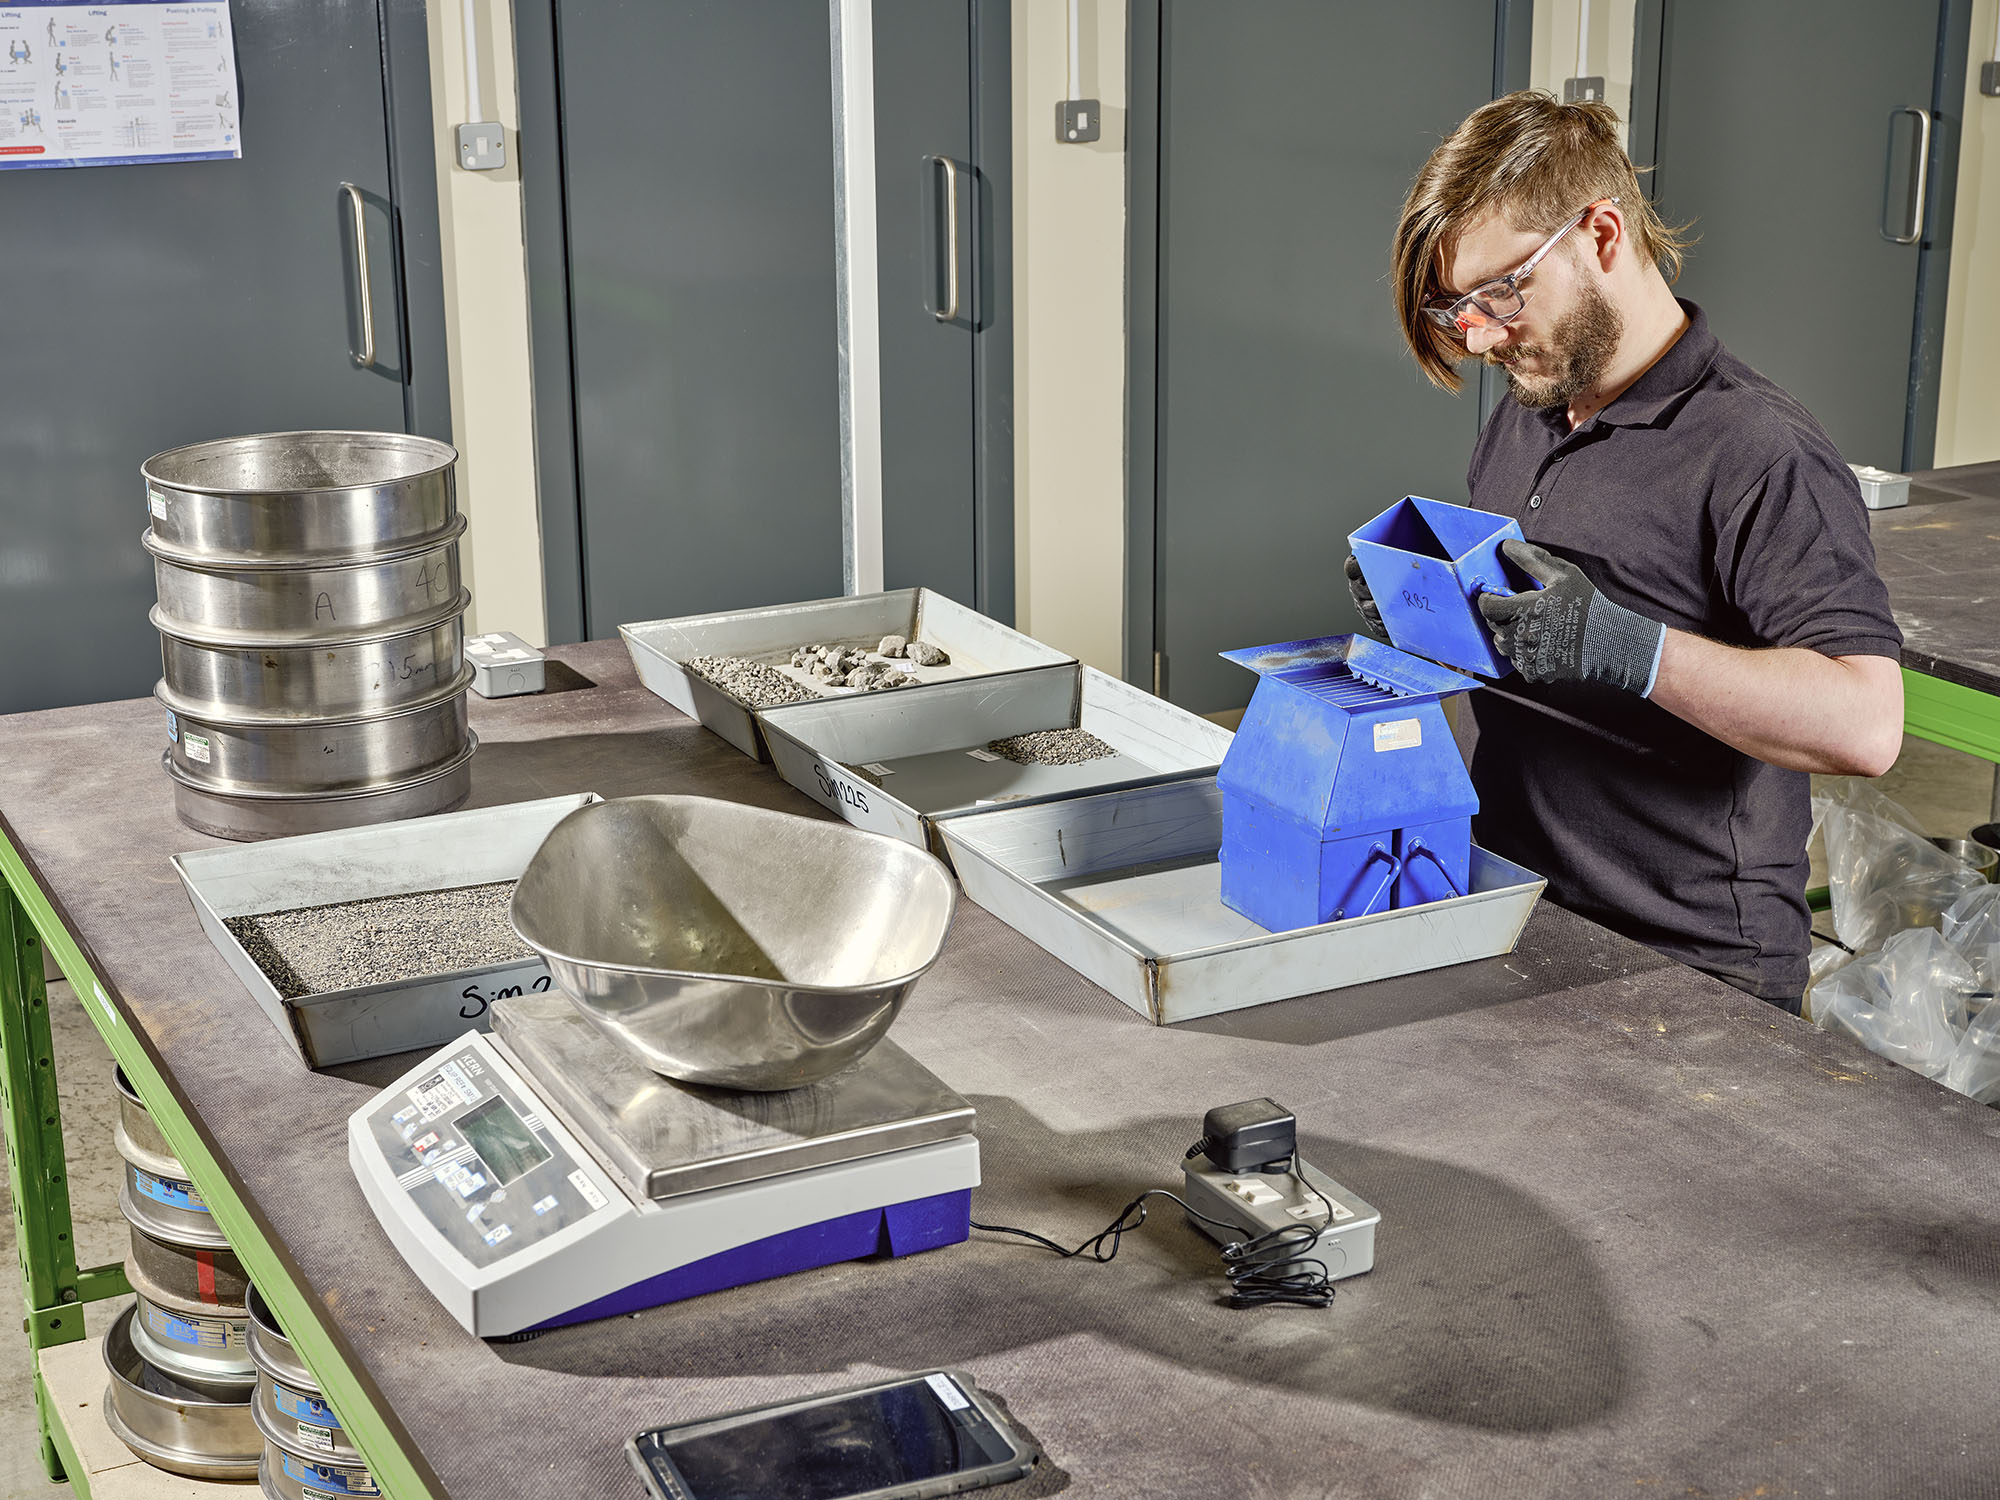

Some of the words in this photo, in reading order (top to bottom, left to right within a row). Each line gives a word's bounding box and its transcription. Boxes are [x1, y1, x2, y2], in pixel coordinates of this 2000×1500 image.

[415, 561, 448, 600] 40
[315, 591, 336, 620] A
[461, 1054, 484, 1076] KERN
